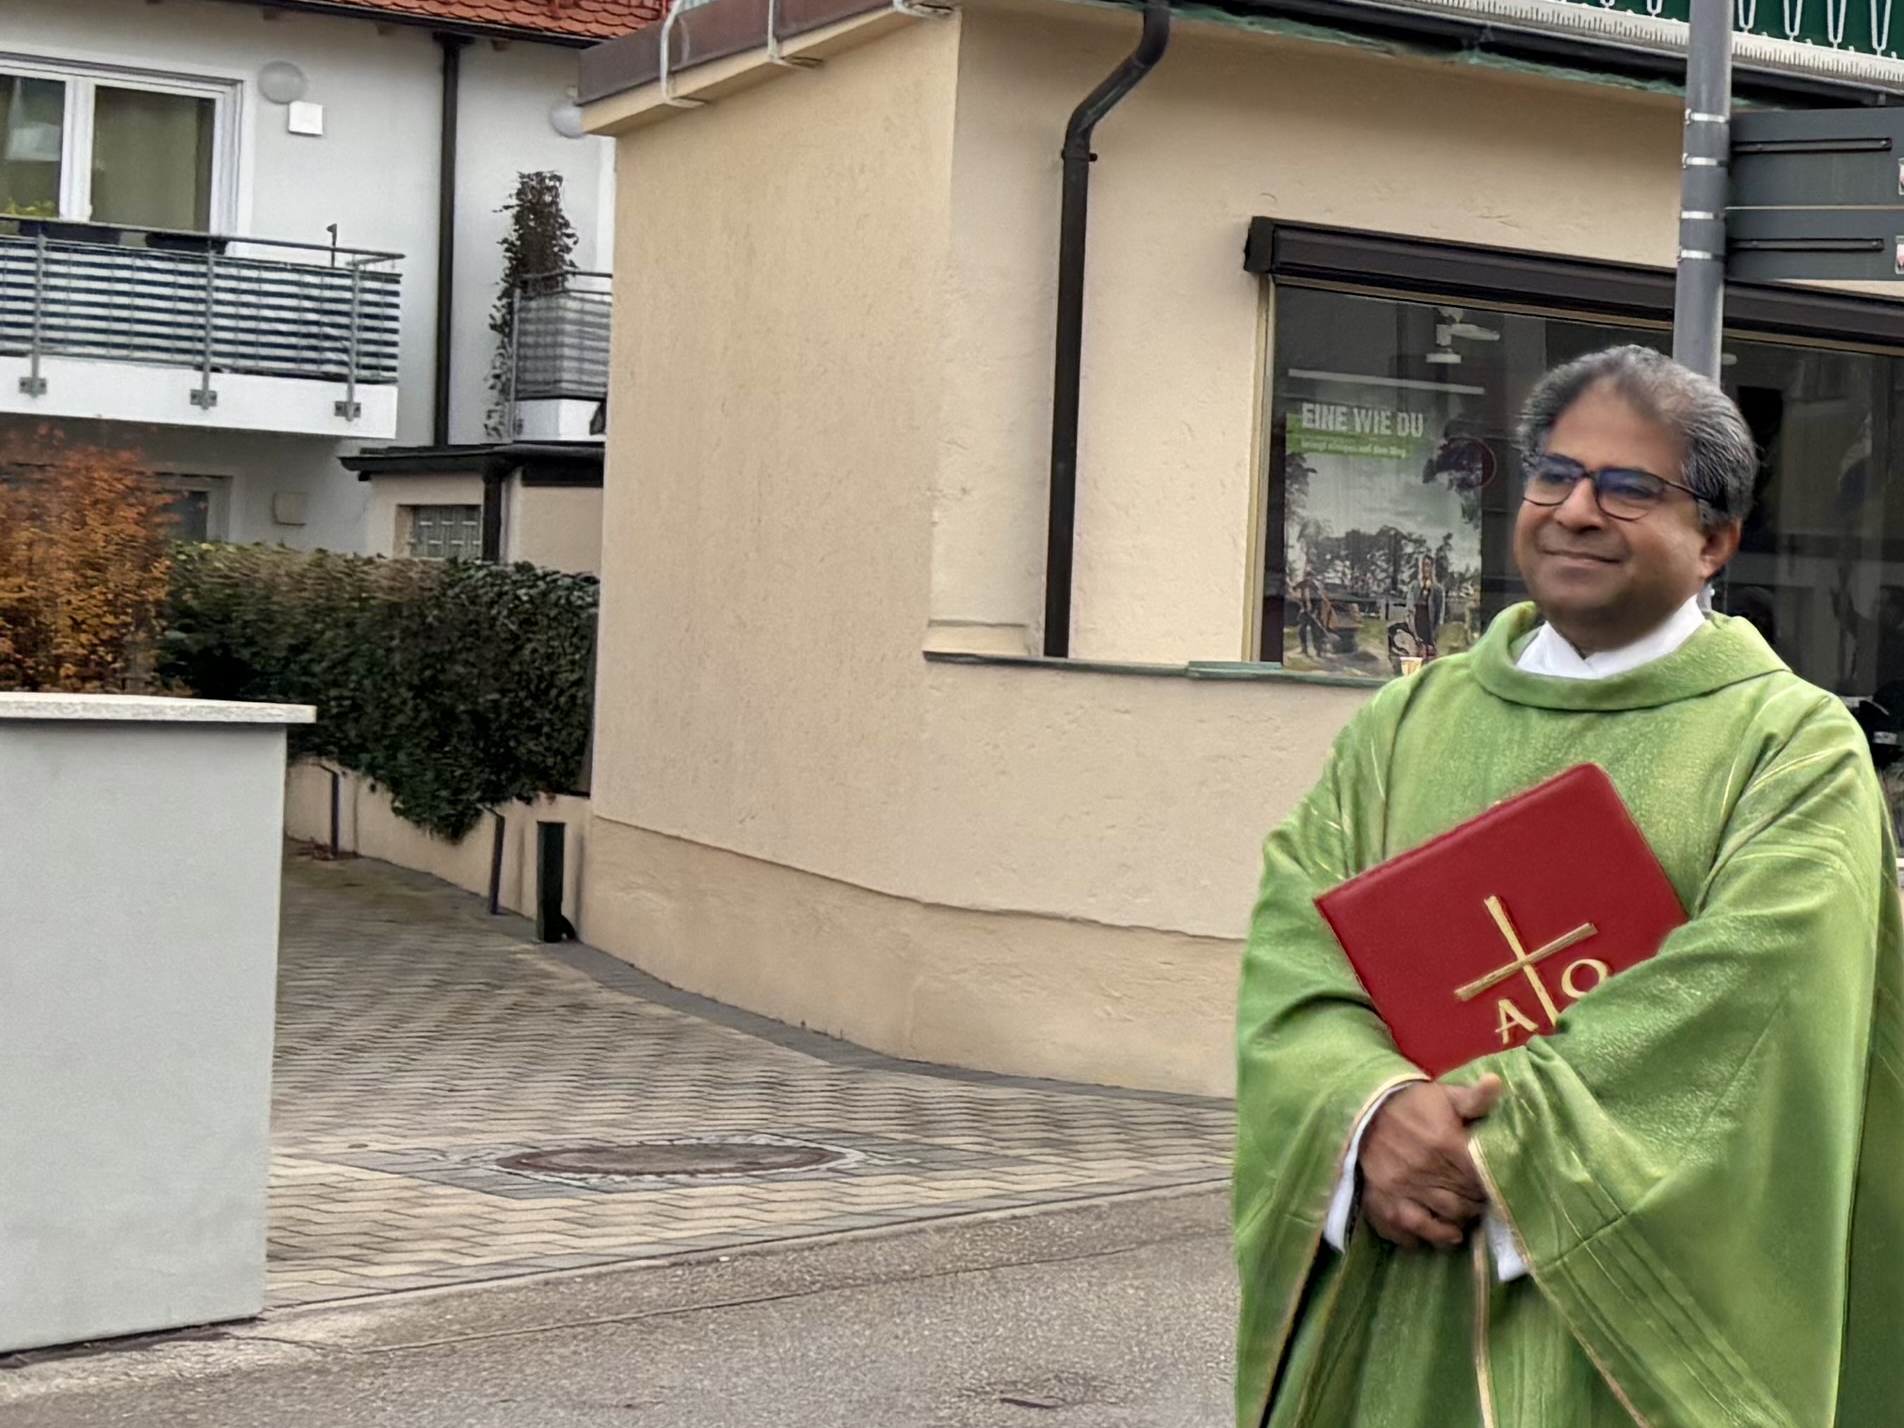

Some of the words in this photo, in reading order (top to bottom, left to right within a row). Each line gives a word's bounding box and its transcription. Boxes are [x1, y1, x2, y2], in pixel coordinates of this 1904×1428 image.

[1302, 402, 1348, 432] EINE
[1352, 407, 1392, 435] WIE
[1396, 411, 1424, 438] DU
